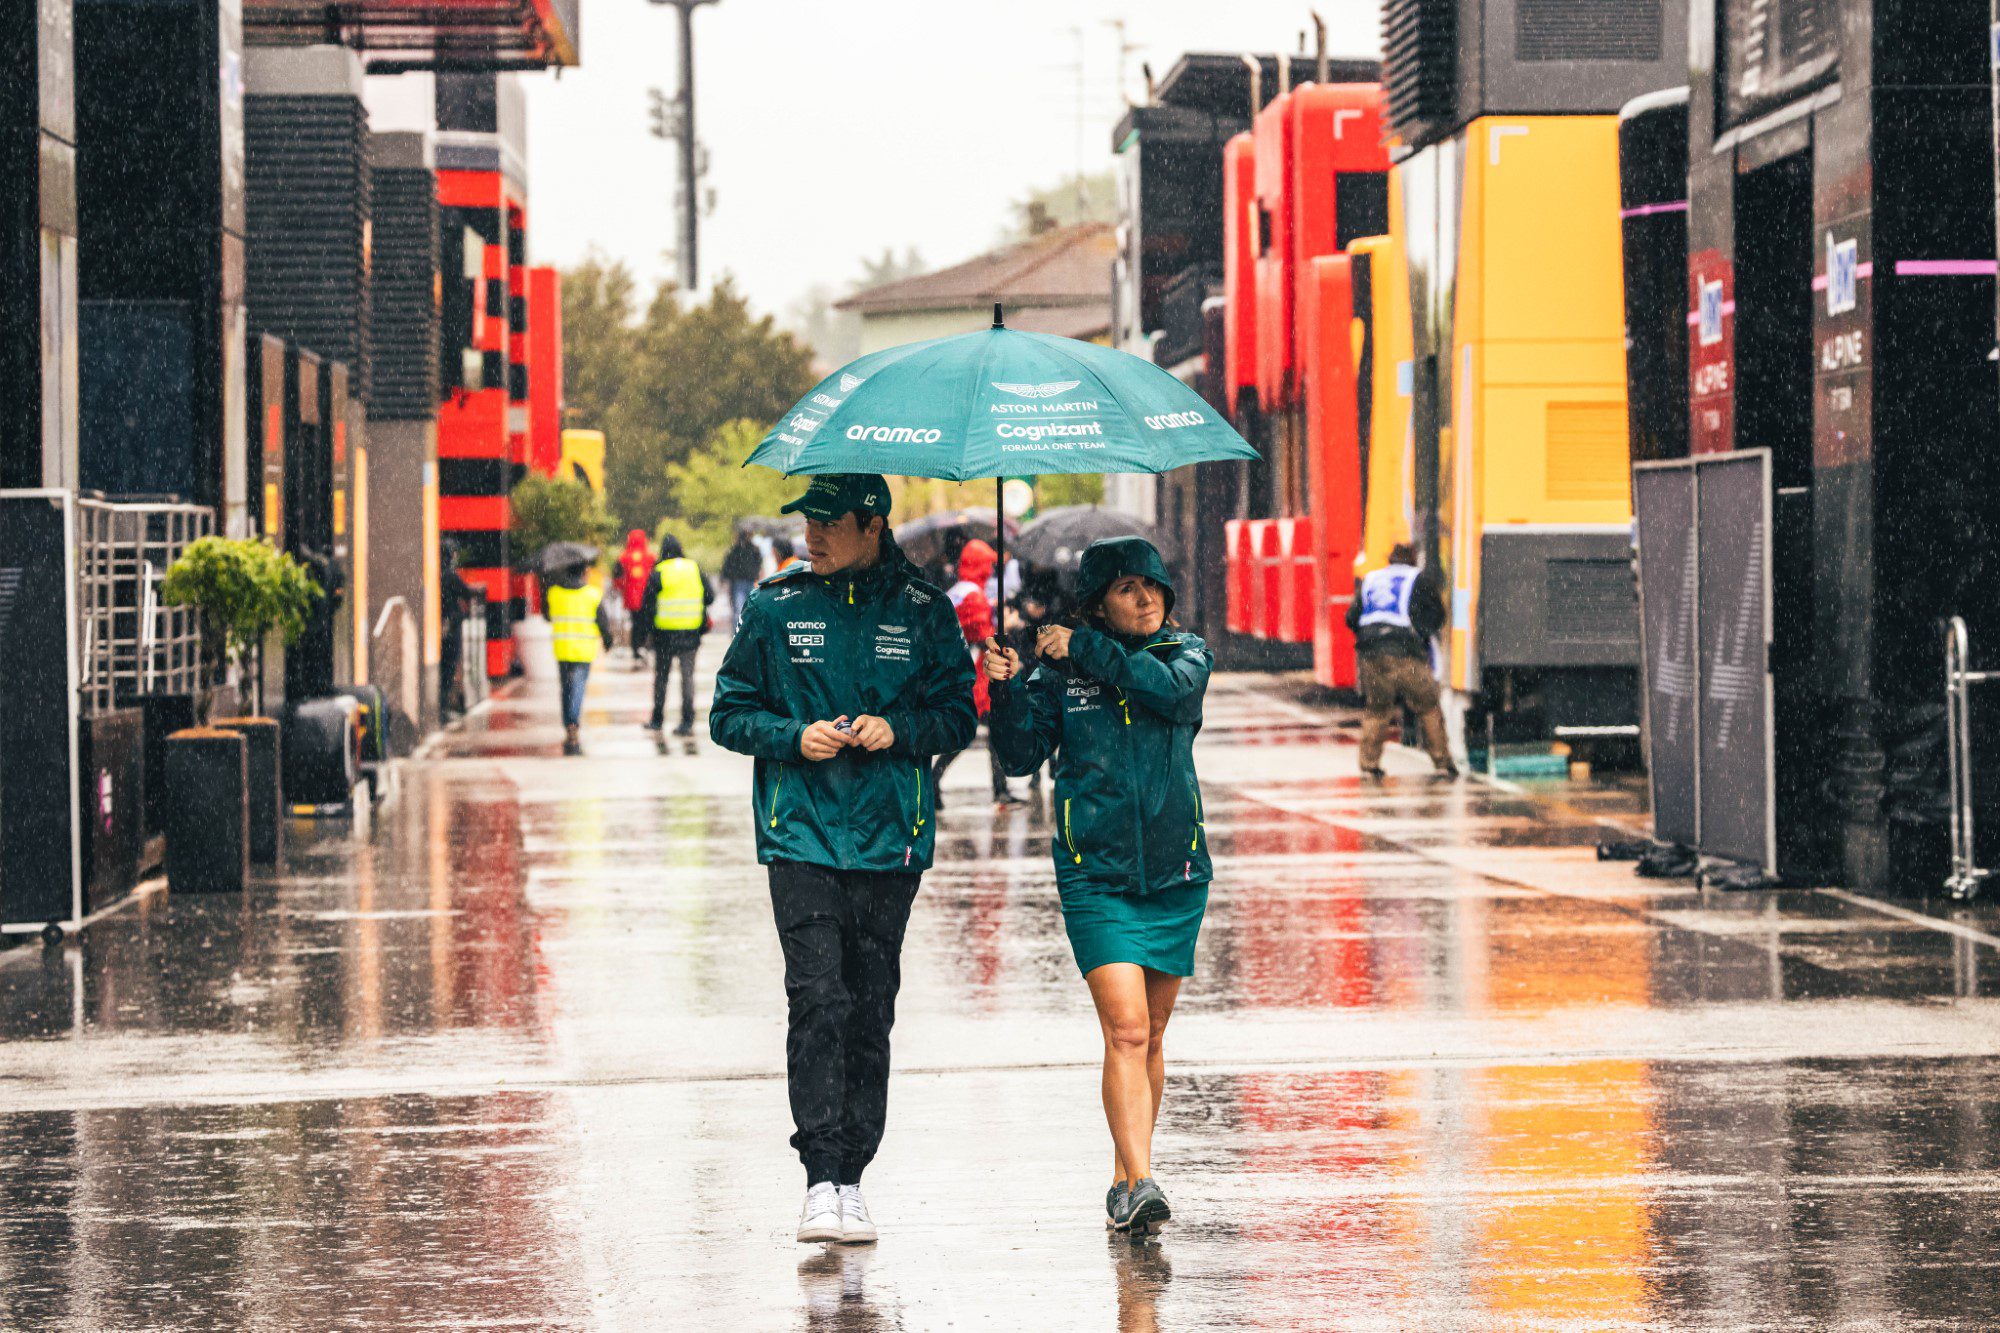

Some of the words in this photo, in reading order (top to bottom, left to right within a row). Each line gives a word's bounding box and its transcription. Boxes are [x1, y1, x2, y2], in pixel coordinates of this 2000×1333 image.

[990, 403, 1038, 414] ASTON
[1042, 400, 1098, 413] MARTIN
[1144, 410, 1204, 429] aramco
[846, 425, 941, 443] aramco
[996, 422, 1102, 441] Cognizant
[1002, 443, 1050, 452] FORMULA
[1078, 442, 1105, 450] TEAM
[774, 590, 802, 601] crypto.com
[786, 621, 826, 630] aramco
[790, 635, 824, 645] JCB
[875, 645, 910, 656] Cognizant
[1068, 704, 1100, 712] SentinelOne
